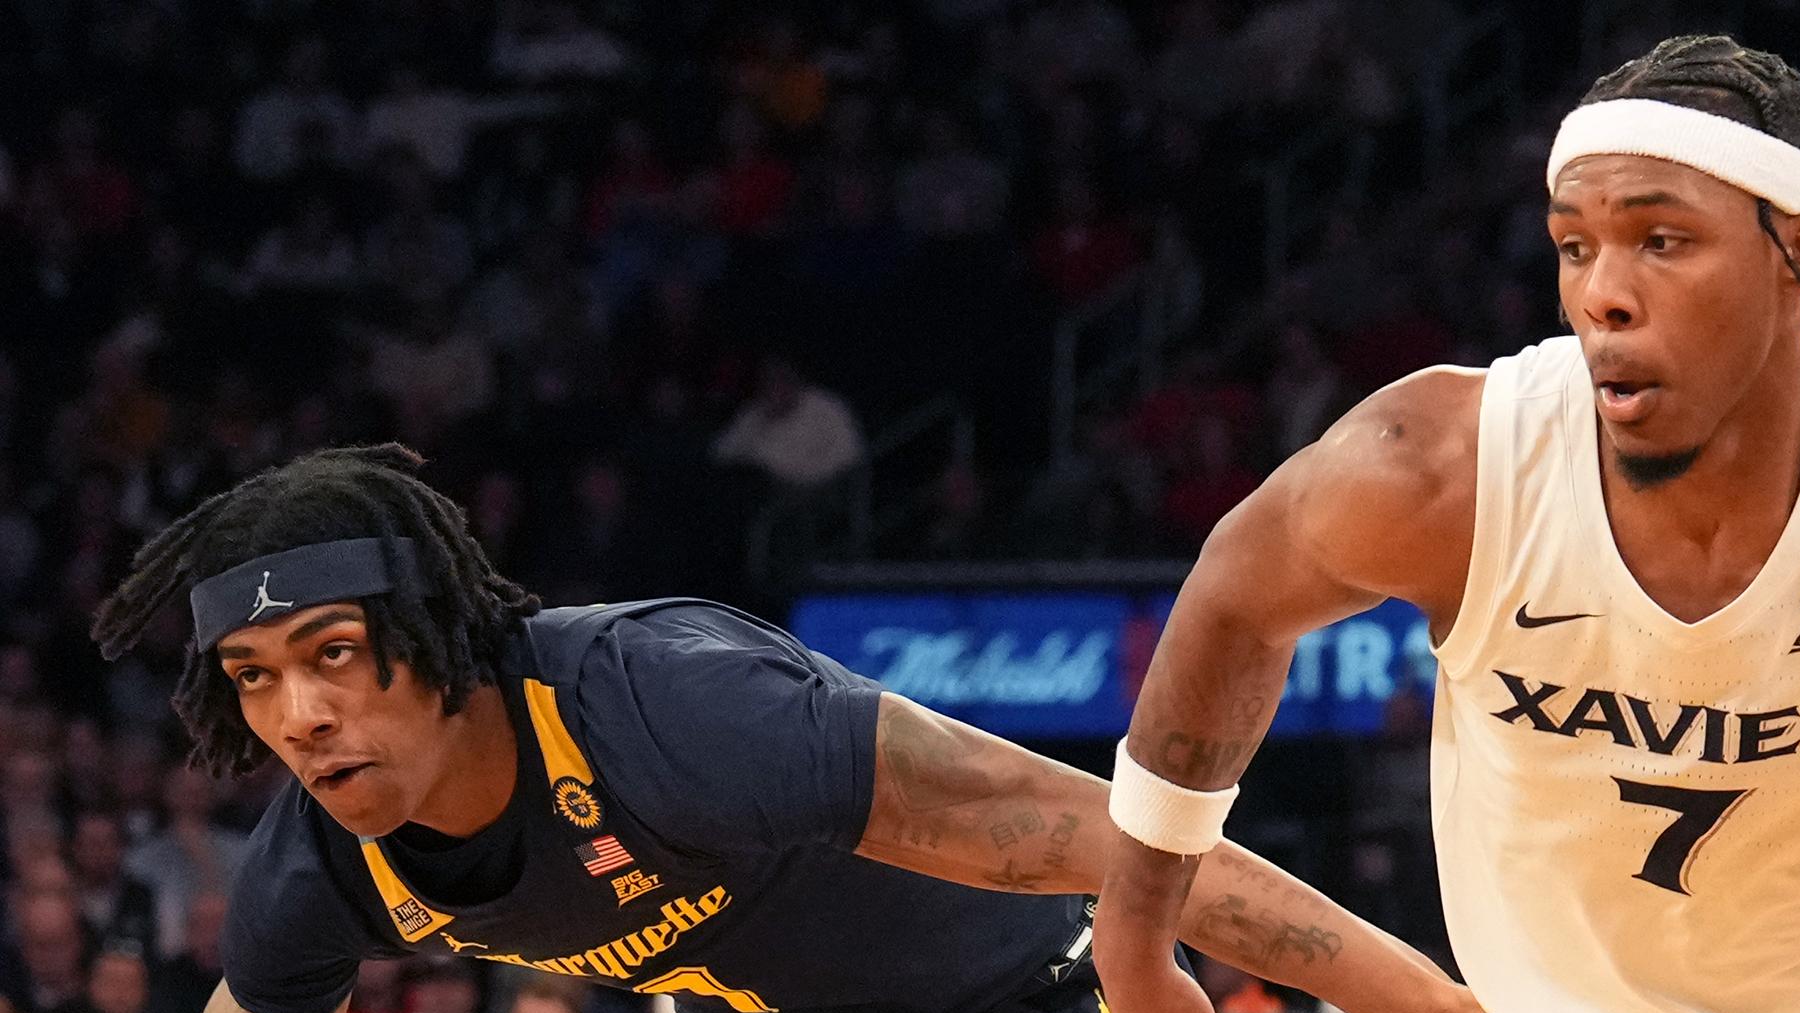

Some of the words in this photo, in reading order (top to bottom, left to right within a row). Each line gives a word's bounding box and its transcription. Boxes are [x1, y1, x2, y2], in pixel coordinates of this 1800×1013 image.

[1610, 776, 1758, 896] 7
[610, 868, 645, 889] BIG
[615, 874, 660, 899] EAST
[396, 899, 420, 921] THE
[401, 909, 432, 934] ANGE
[475, 884, 734, 980] arquette
